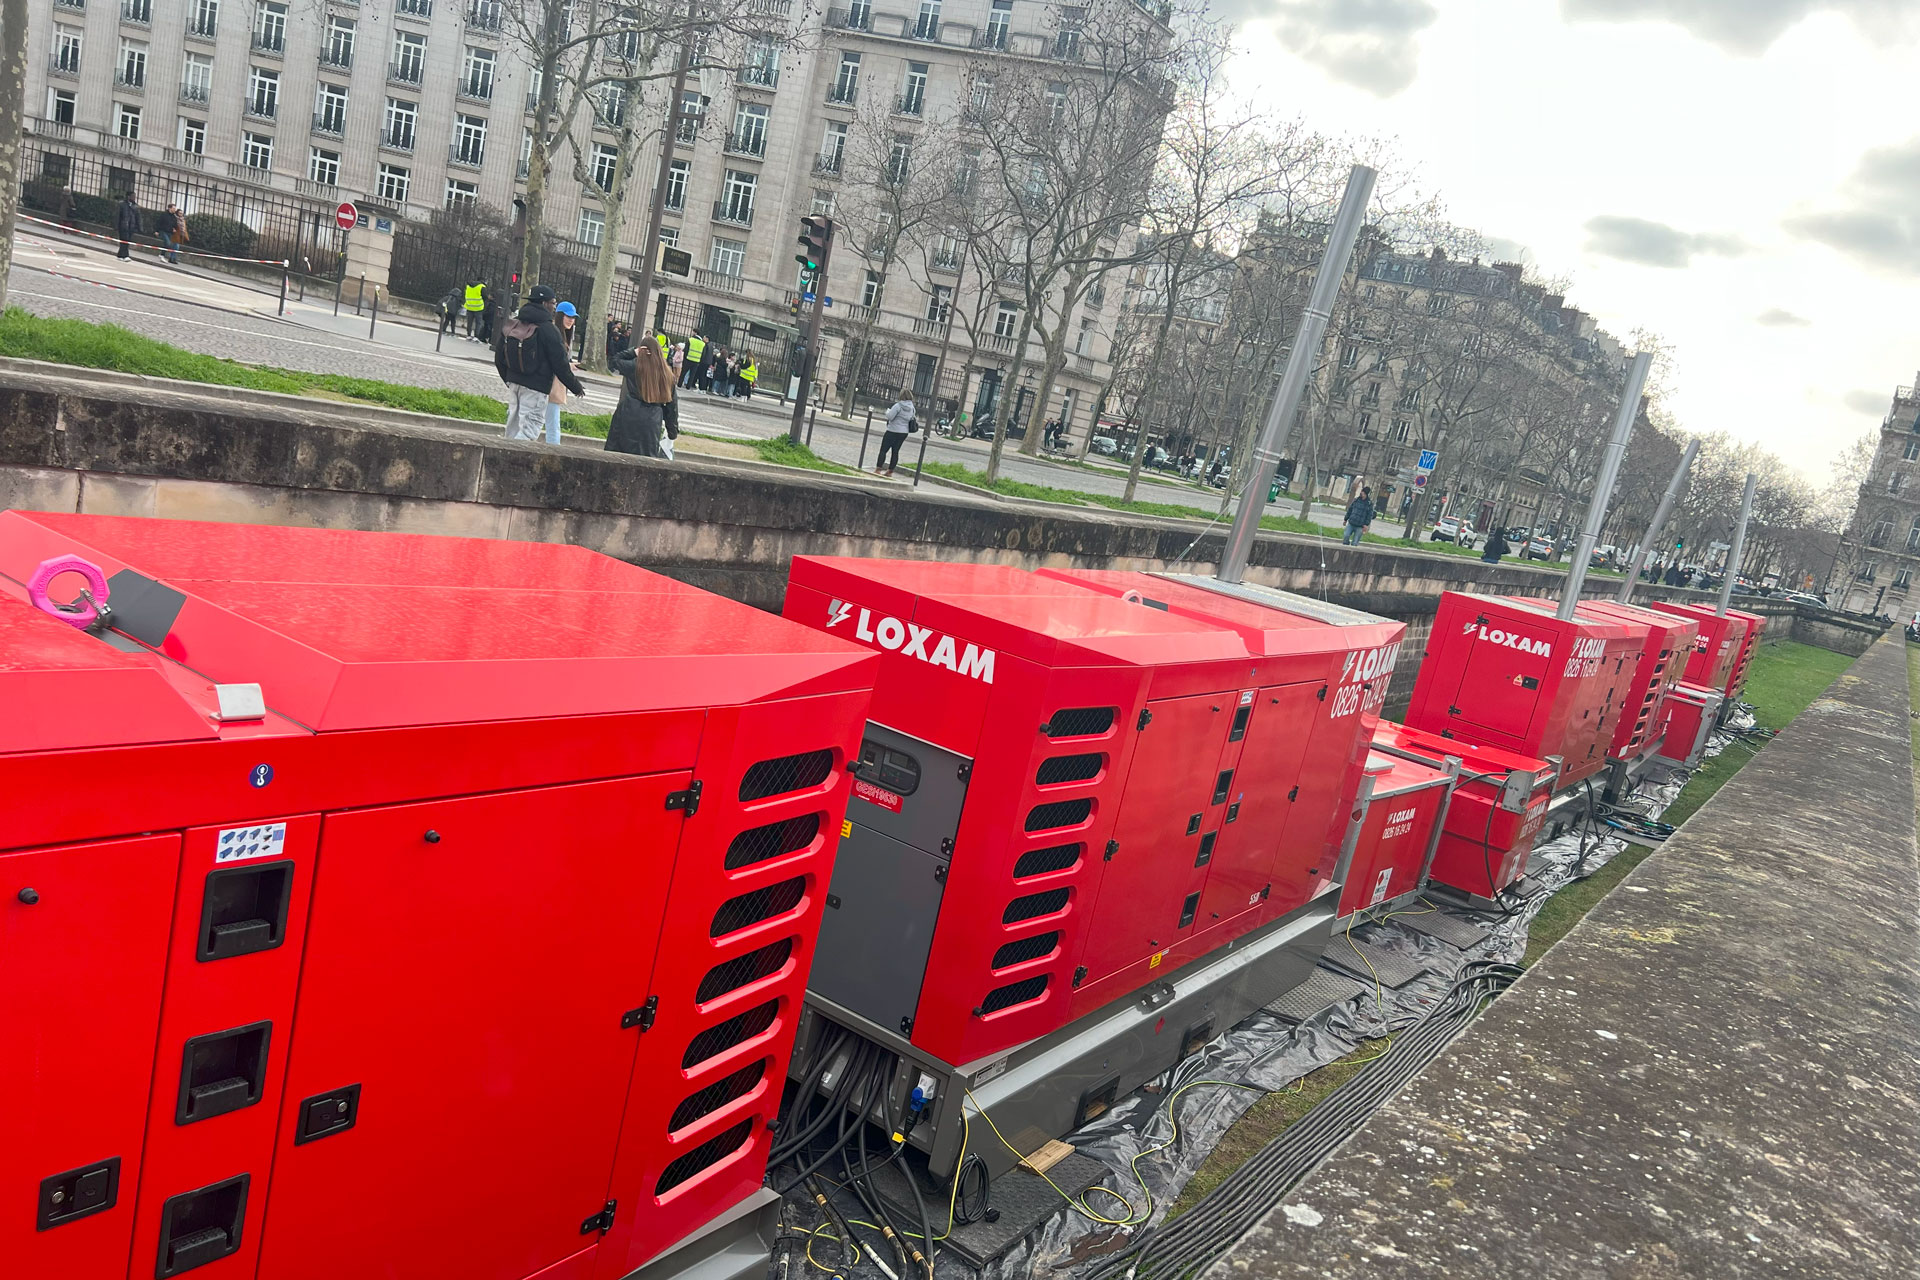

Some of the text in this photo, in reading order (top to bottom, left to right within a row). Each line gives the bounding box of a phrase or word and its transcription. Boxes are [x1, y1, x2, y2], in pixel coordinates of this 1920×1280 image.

[856, 607, 996, 685] LOXAM
[1478, 625, 1551, 658] LOXAM
[1578, 638, 1607, 658] LOXAM
[1352, 642, 1401, 683] LOXAM
[1330, 683, 1362, 719] 0826
[1392, 807, 1416, 825] LOXAM
